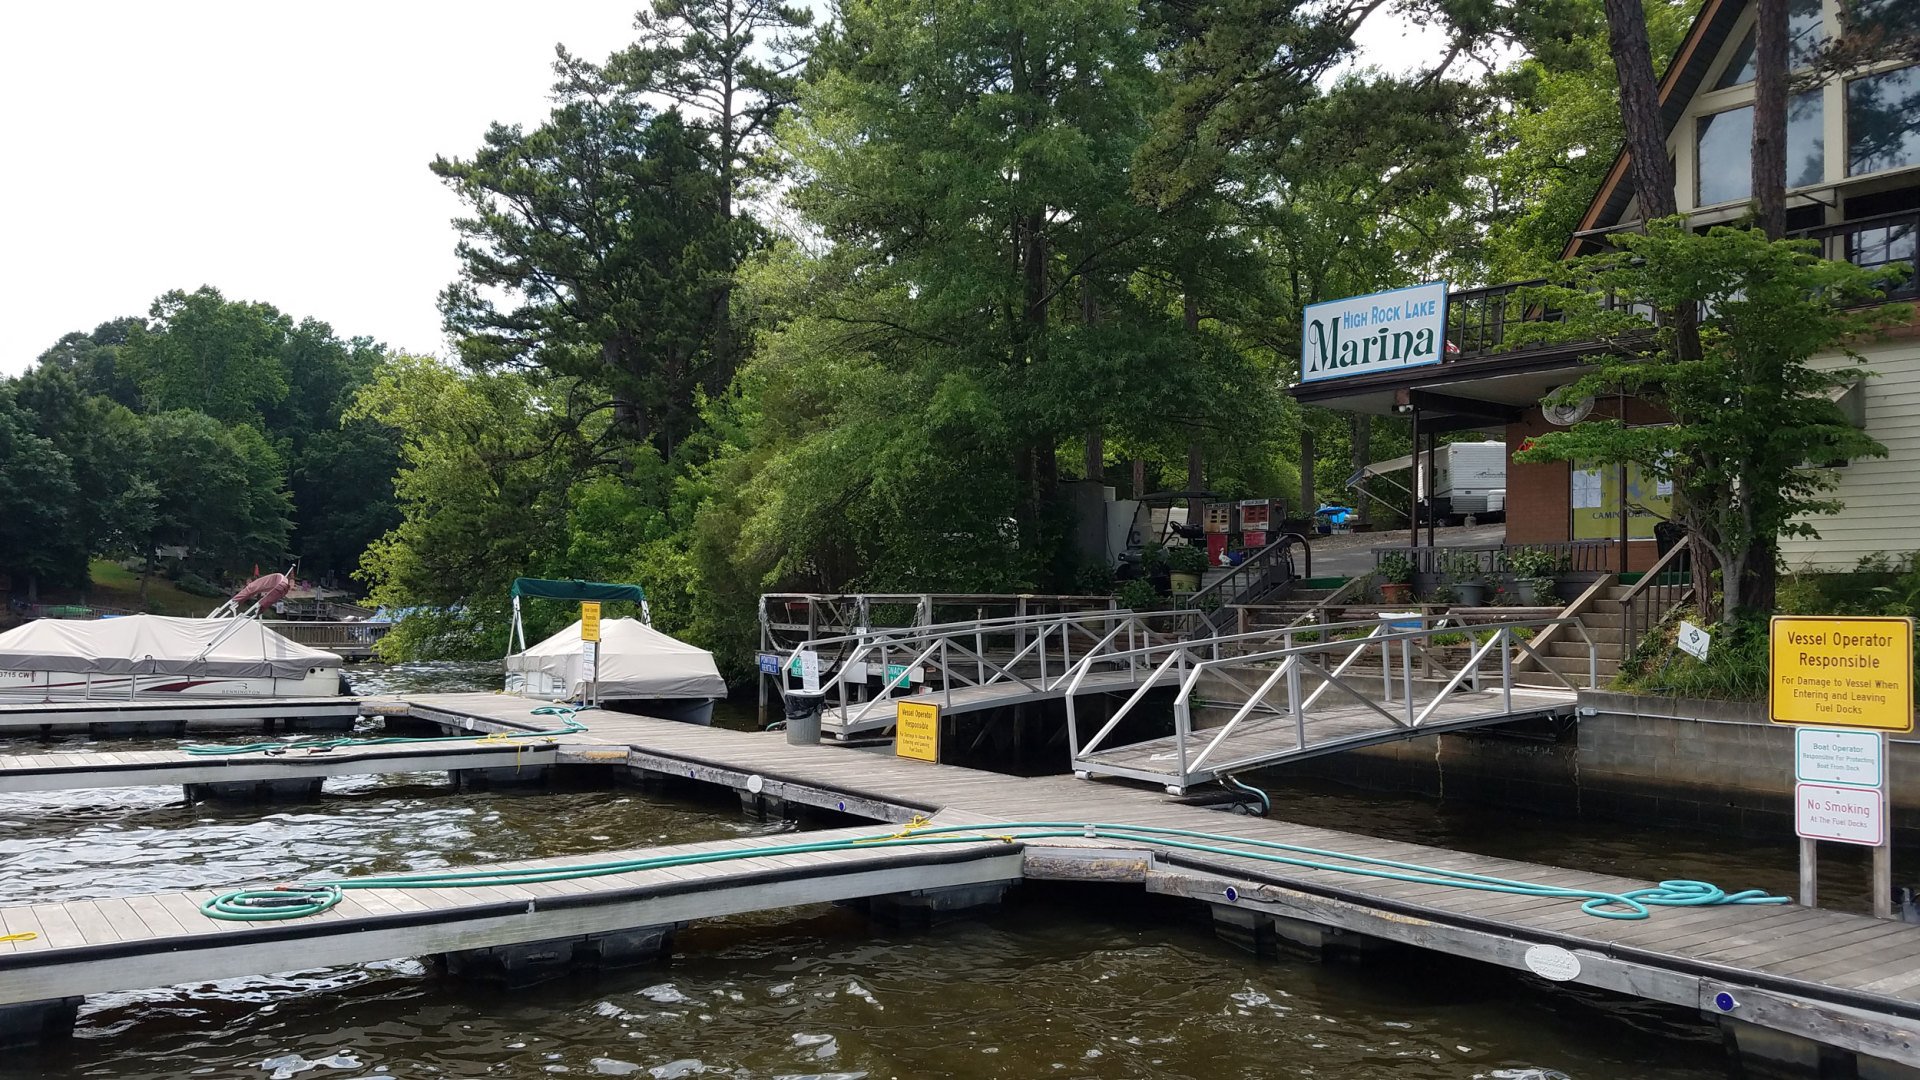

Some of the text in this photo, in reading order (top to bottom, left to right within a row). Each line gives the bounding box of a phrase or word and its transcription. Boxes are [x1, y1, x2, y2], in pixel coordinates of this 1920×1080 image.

[1343, 300, 1436, 329] HIGH ROCK LAKE
[1309, 316, 1435, 373] Marina
[1787, 631, 1893, 648] Vessel Operator
[1799, 652, 1880, 669] Responsible
[1781, 676, 1899, 690] For Damage to Vessel When
[1793, 689, 1886, 704] Entering and Leaving
[1815, 703, 1863, 714] Fuel Docks
[1813, 743, 1864, 753] Boat Operator
[1807, 798, 1870, 818] No Smoking
[1810, 815, 1868, 828] At The Fuel Docks
